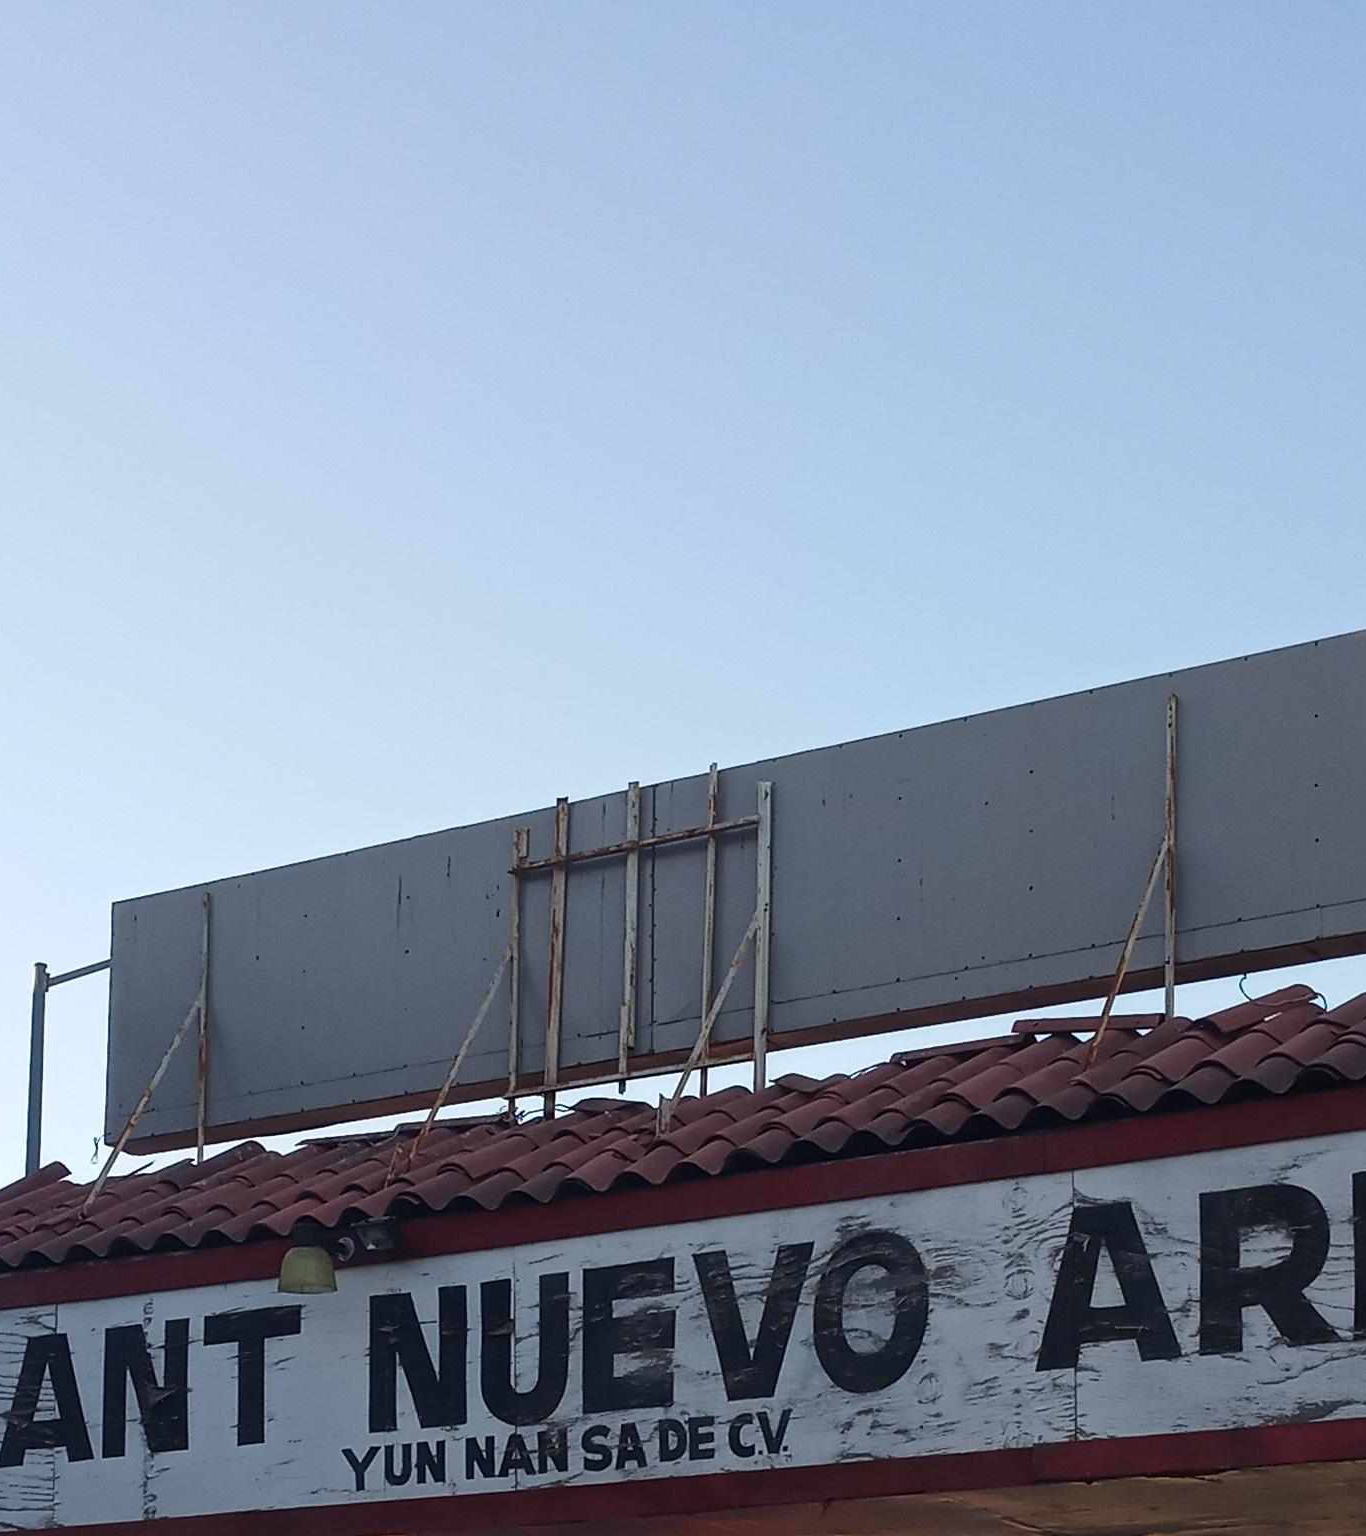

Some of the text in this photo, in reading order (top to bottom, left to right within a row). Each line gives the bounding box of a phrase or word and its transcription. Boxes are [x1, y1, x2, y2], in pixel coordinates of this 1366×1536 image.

[368, 1231, 929, 1433] NUEVO
[341, 1438, 446, 1492] YUN
[465, 1421, 570, 1480] NAN
[658, 1414, 715, 1462] DE
[727, 1408, 793, 1458] C.V.
